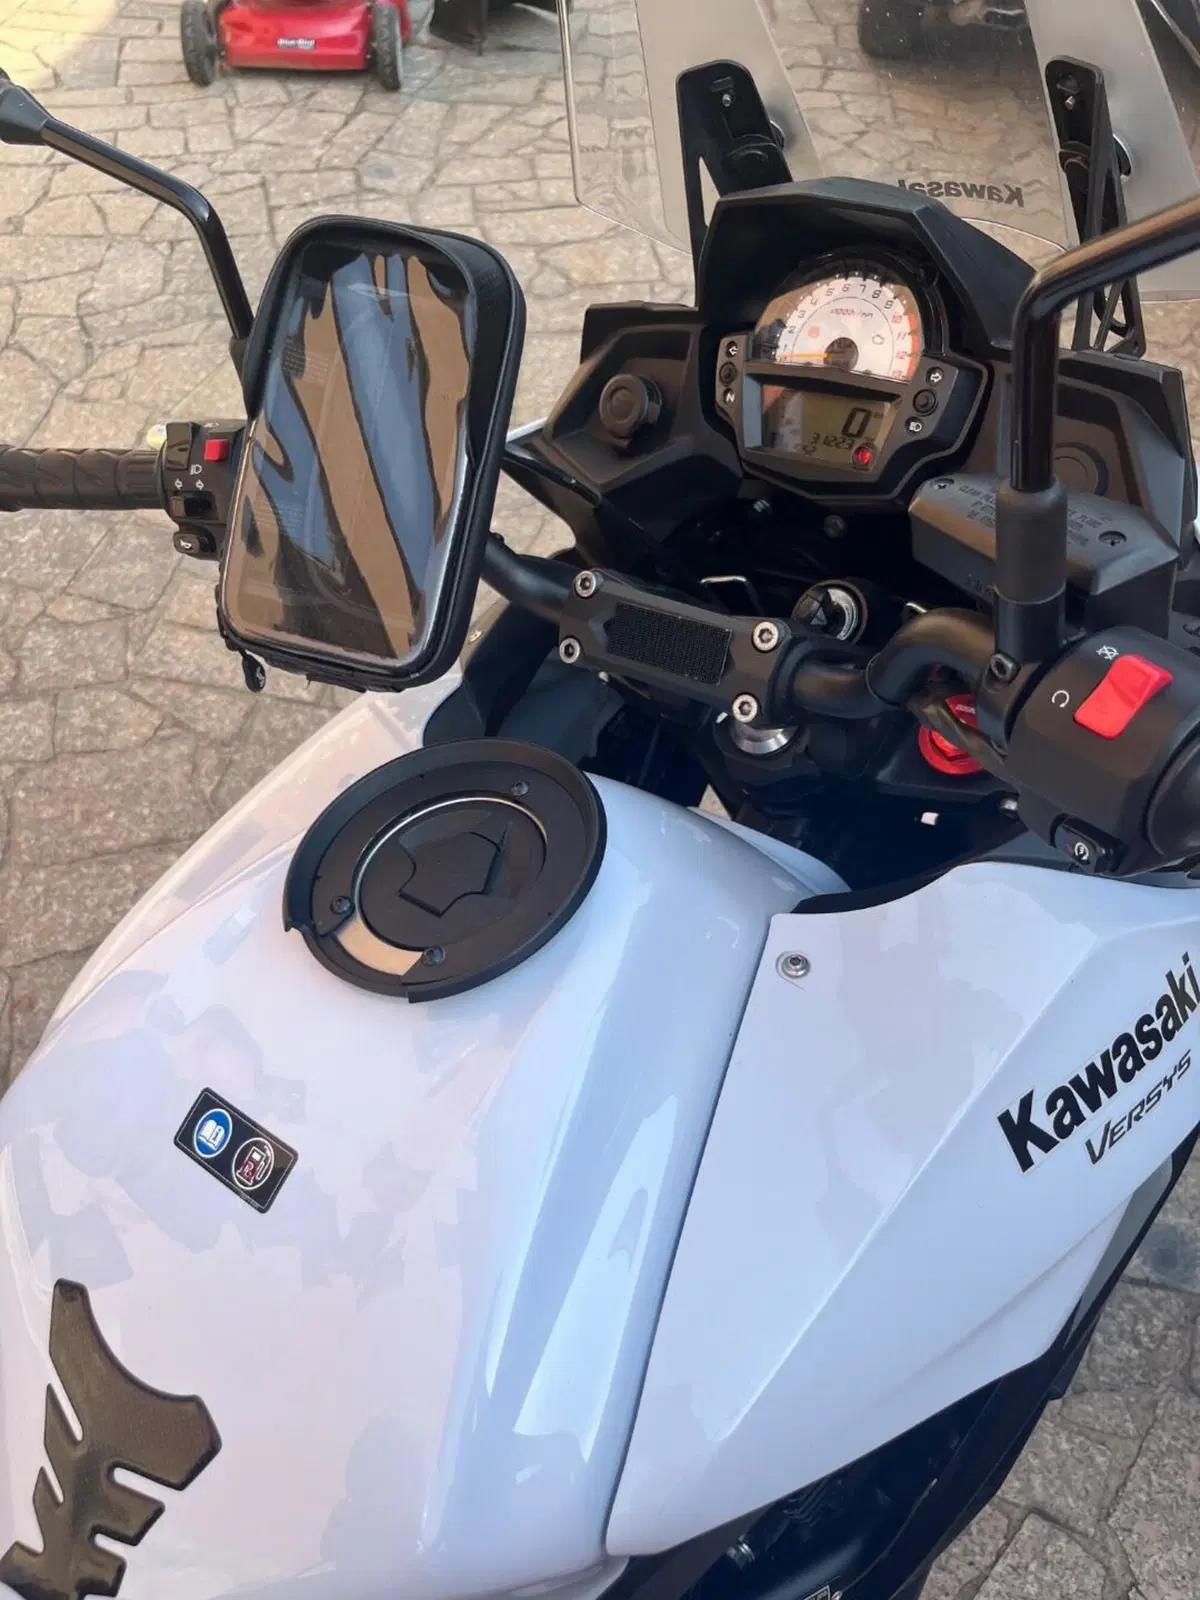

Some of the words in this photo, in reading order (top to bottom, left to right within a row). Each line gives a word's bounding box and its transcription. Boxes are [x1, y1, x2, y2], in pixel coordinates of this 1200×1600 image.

[860, 285, 867, 293] 7
[871, 289, 882, 299] 8
[726, 393, 736, 402] N
[842, 407, 872, 437] 0
[997, 951, 1200, 1173] Kawasaki
[1085, 1049, 1192, 1165] VERSYS
